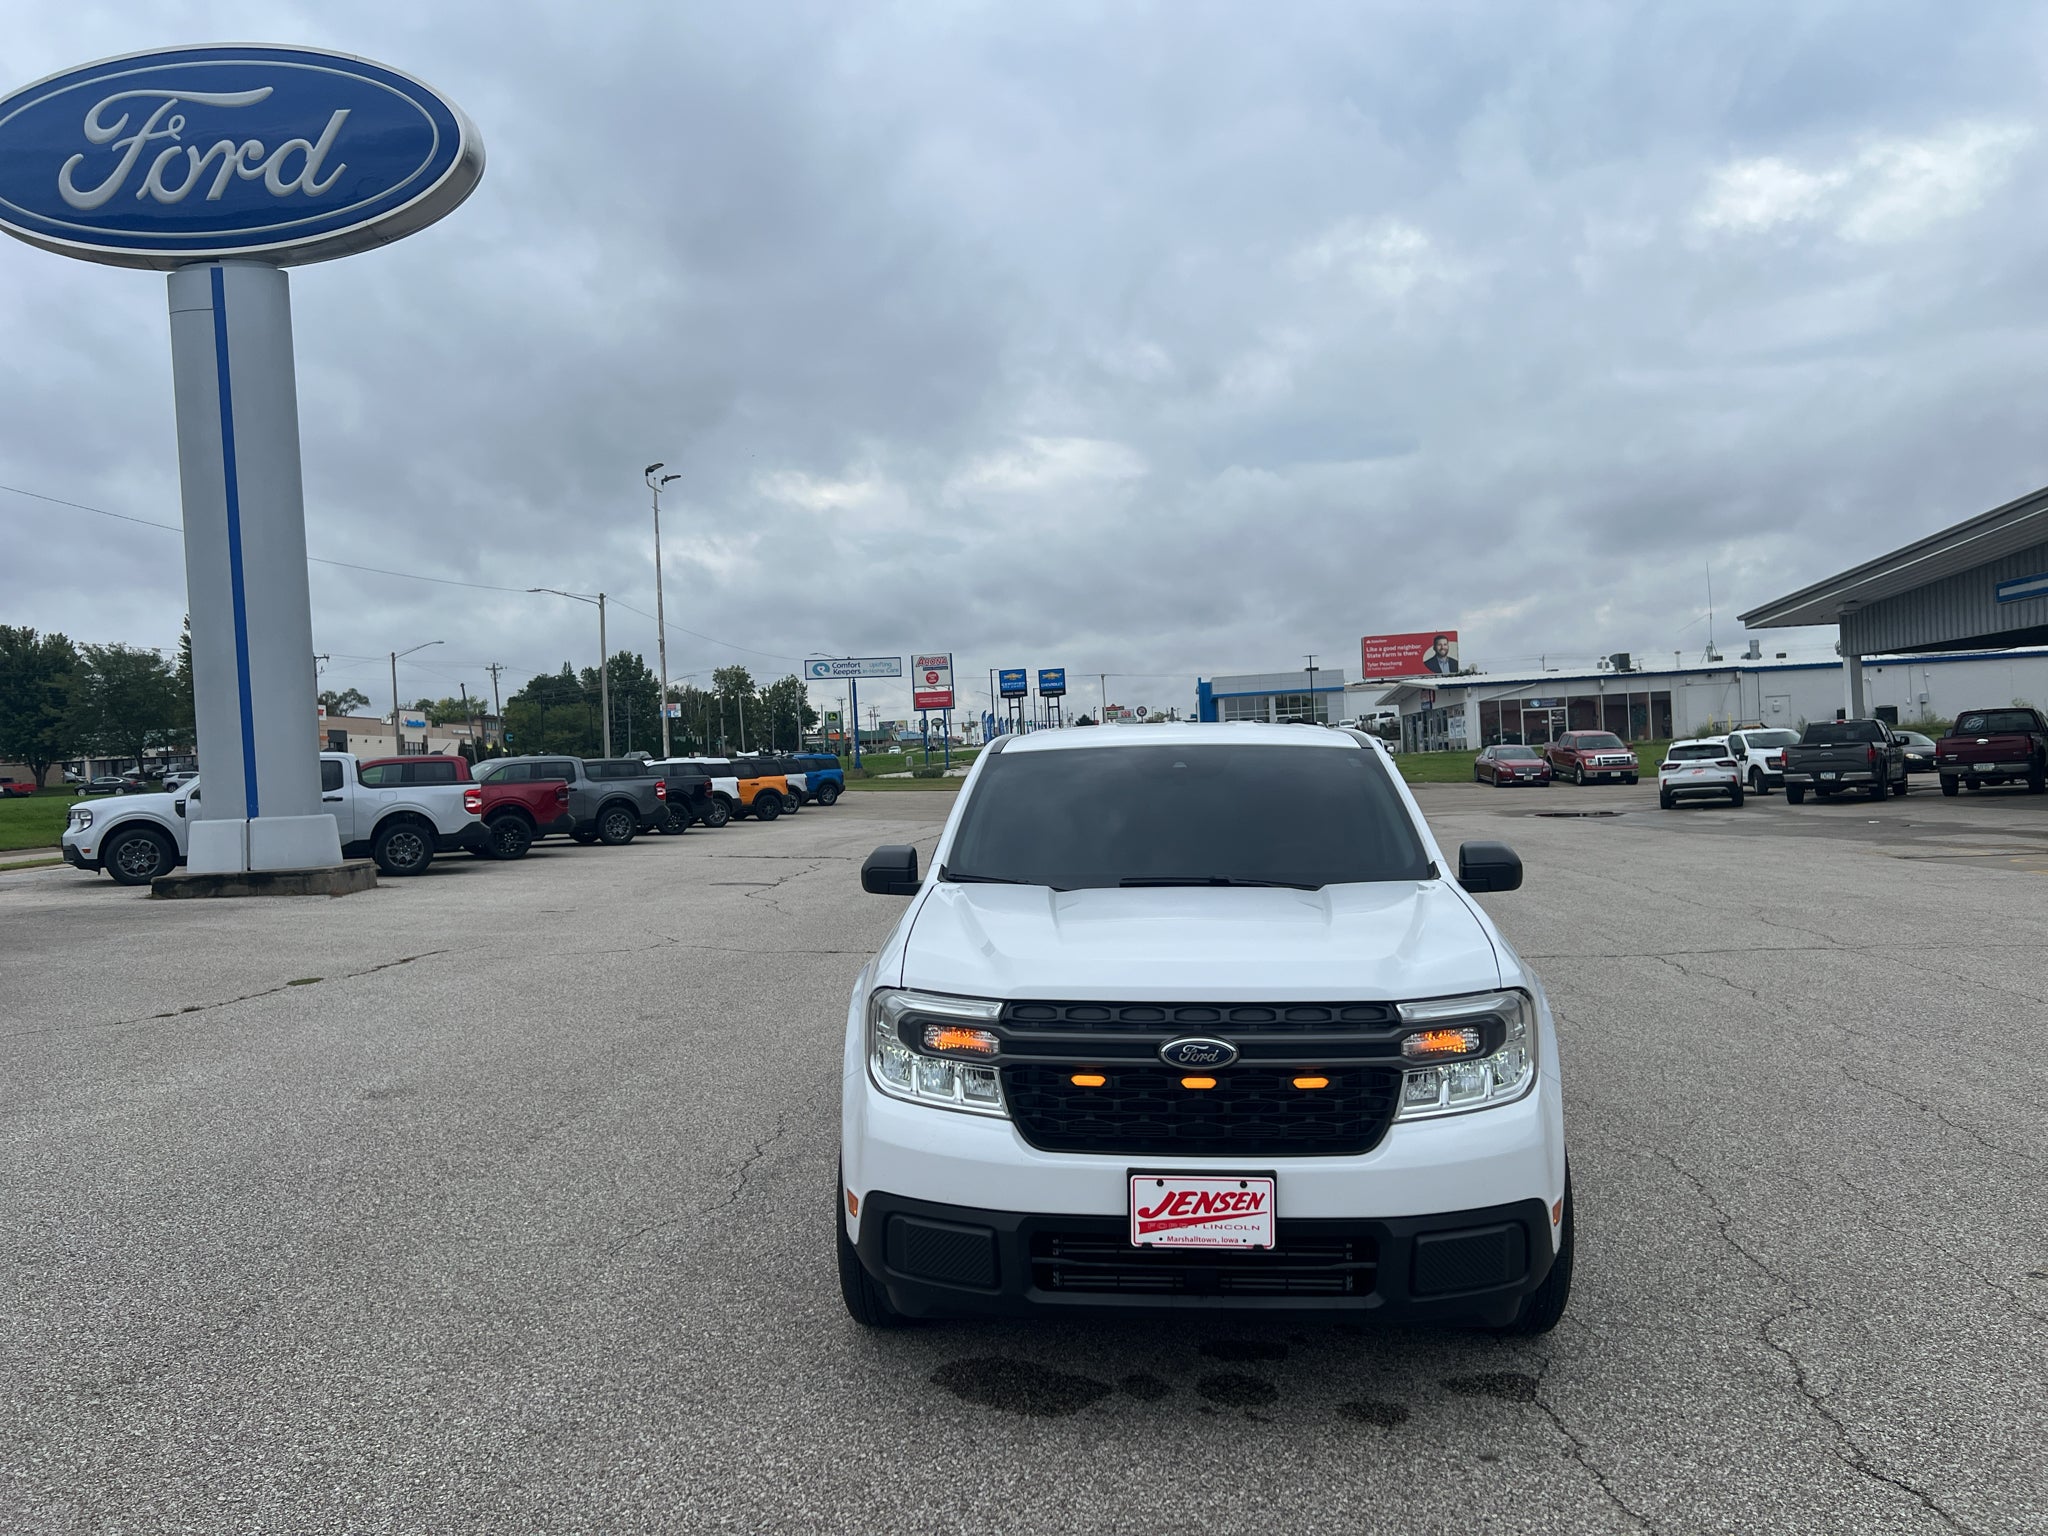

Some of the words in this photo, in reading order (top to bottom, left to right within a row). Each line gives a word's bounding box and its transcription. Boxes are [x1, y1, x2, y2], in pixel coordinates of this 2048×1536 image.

[58, 86, 351, 210] Ford
[832, 661, 861, 669] Comfort
[833, 668, 861, 676] Keepers
[1179, 1045, 1219, 1062] Ford
[1138, 1191, 1266, 1219] JENSEN
[1167, 1235, 1220, 1243] Marshalltown,
